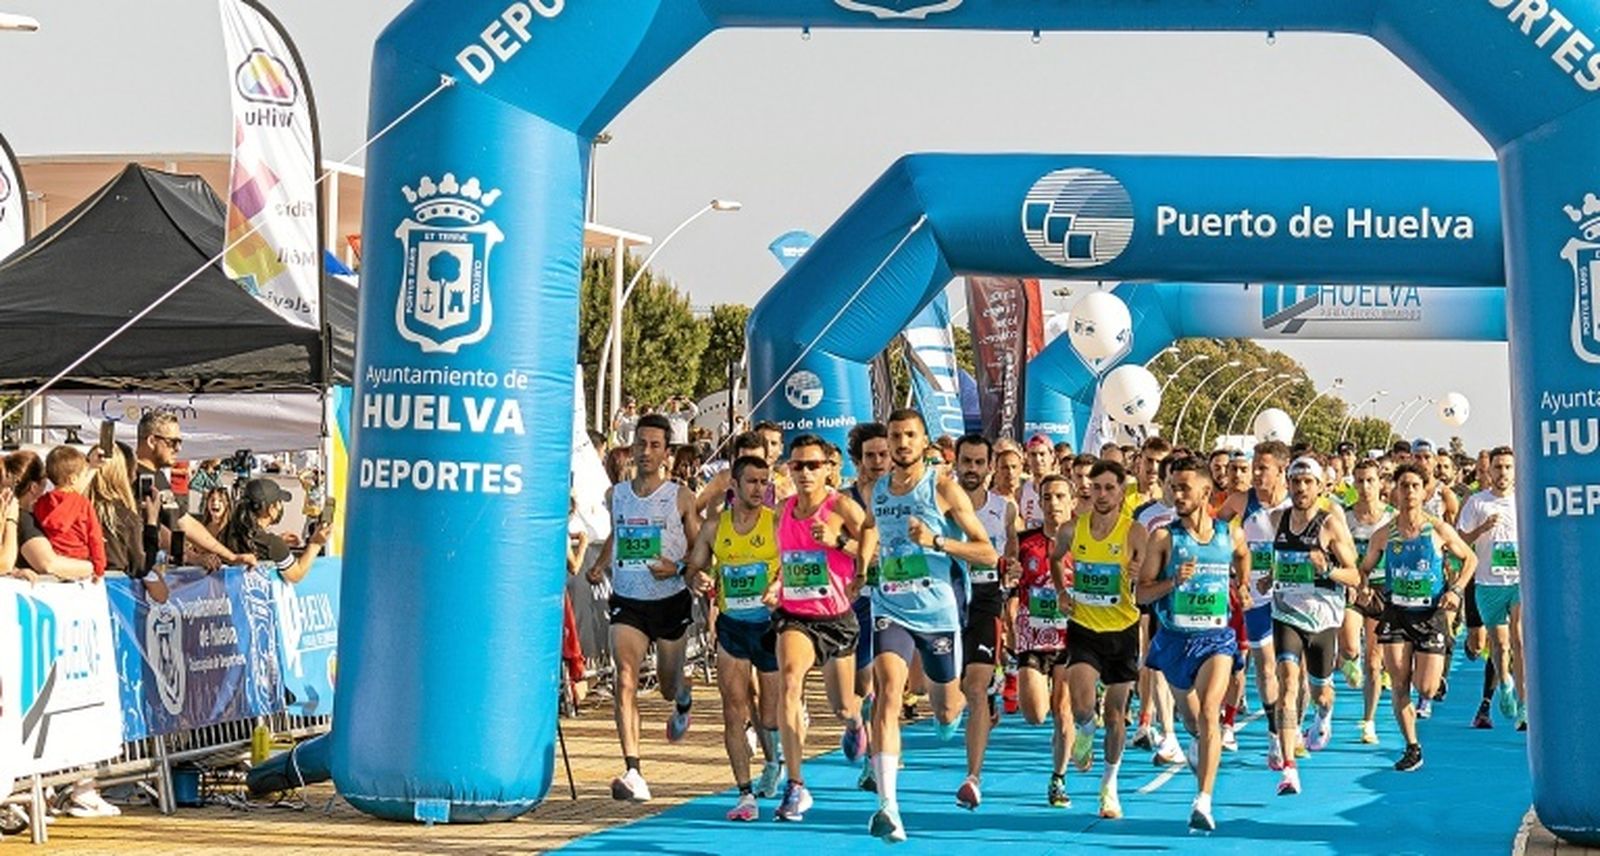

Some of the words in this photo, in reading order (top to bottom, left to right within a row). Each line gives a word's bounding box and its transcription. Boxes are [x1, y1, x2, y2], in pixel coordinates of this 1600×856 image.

[1488, 0, 1600, 91] RTES
[1156, 205, 1277, 237] Puerto
[1288, 206, 1334, 238] de
[1347, 207, 1474, 239] Huelva
[366, 365, 499, 388] Ayuntamiento
[503, 369, 529, 389] de
[361, 393, 526, 435] HUELVA
[359, 457, 524, 495] DEPORTES
[786, 563, 821, 576] 1068
